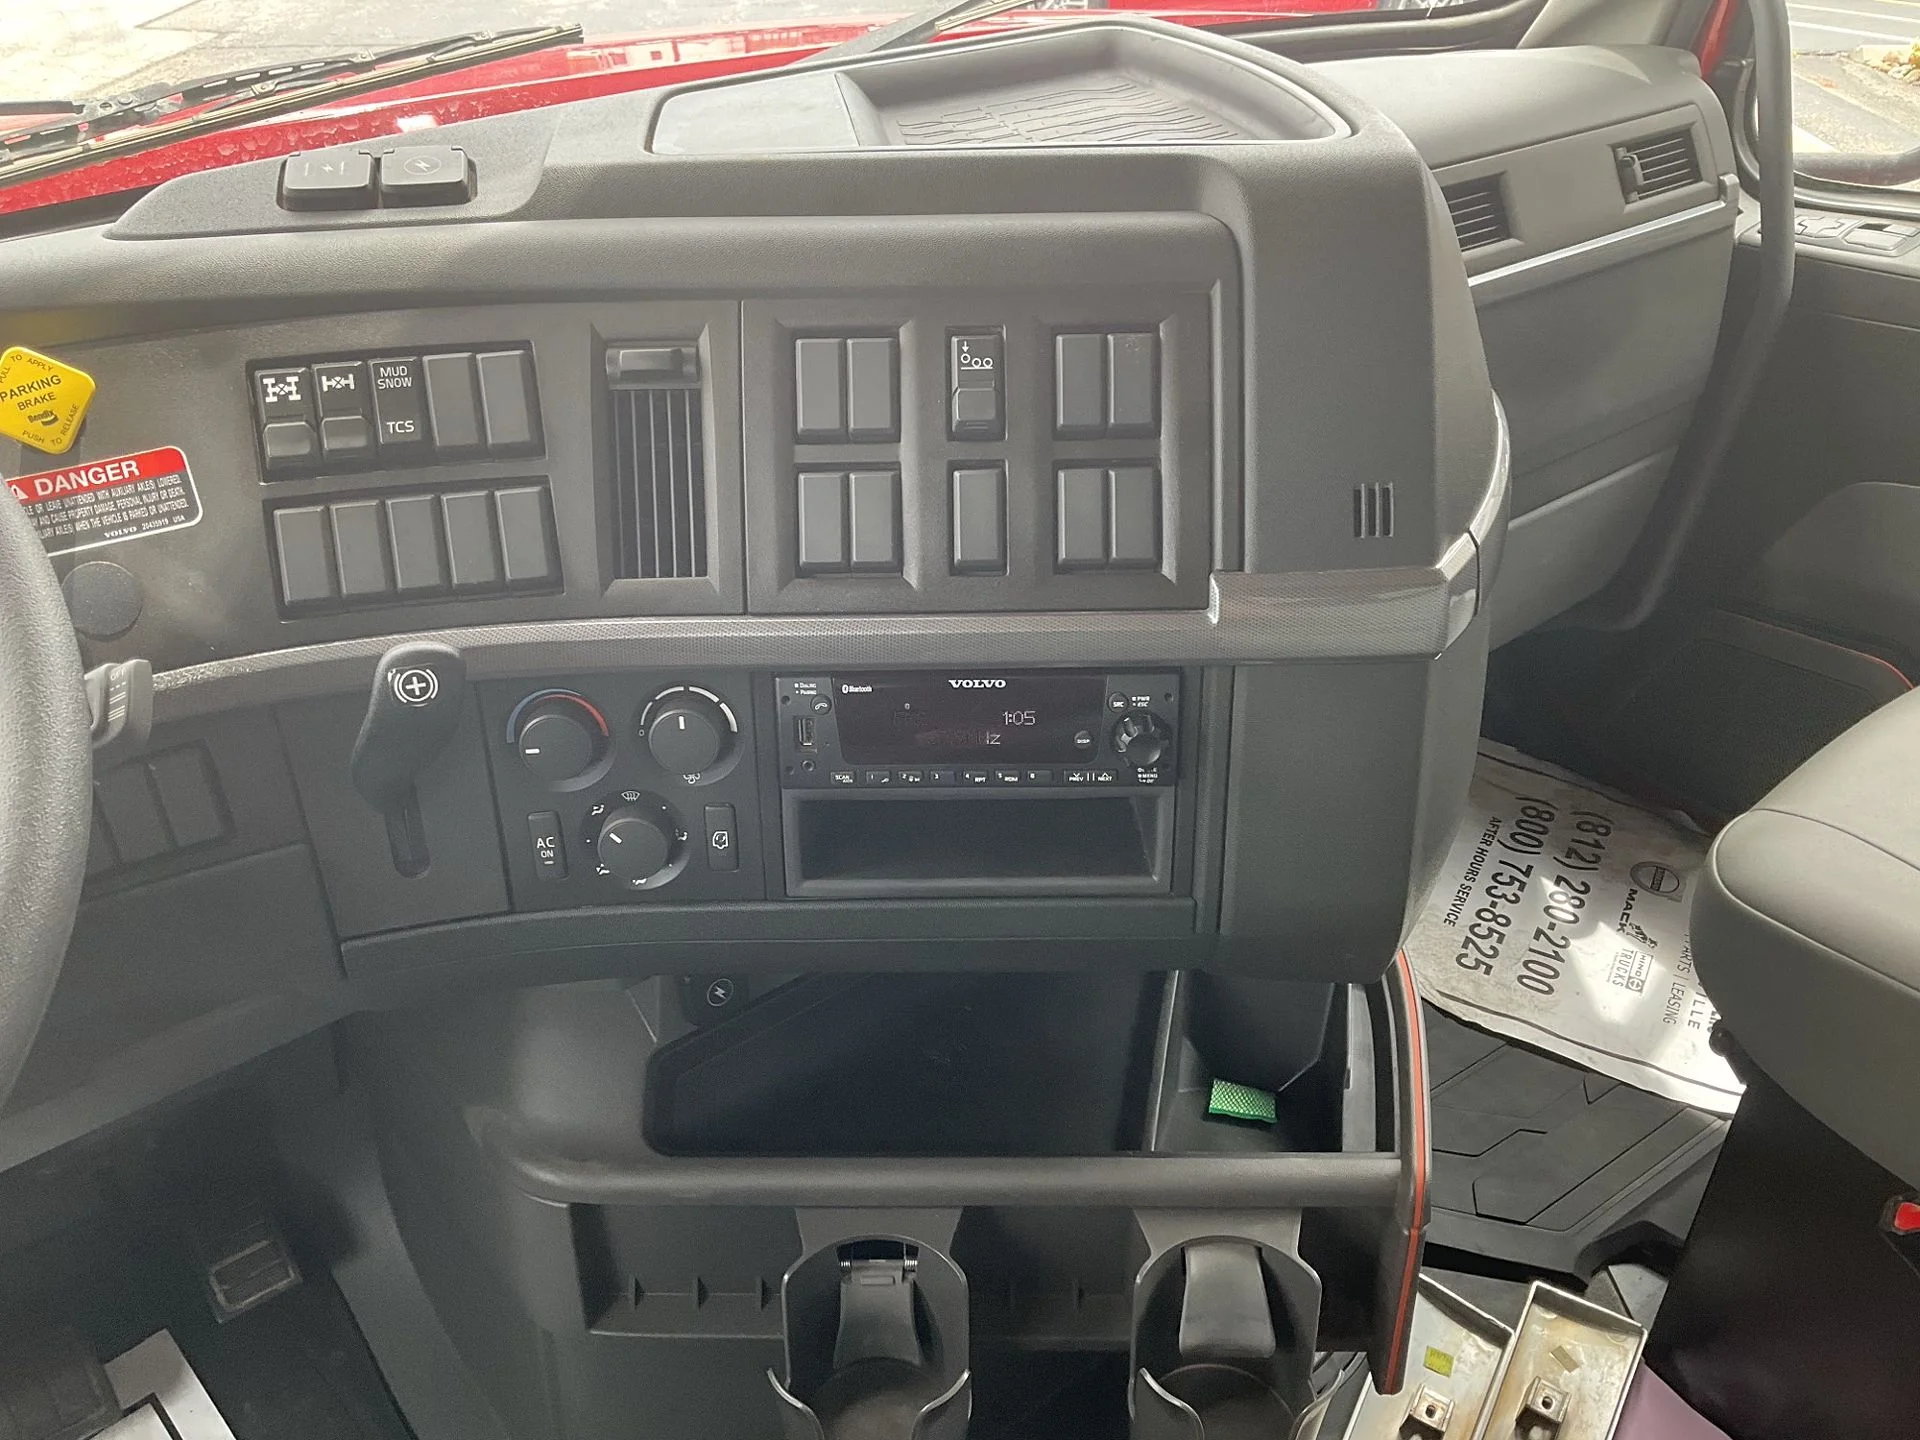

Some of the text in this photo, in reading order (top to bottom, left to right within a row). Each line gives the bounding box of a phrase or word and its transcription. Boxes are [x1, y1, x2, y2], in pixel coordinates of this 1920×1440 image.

[11, 354, 23, 363] TO
[27, 358, 54, 372] APPLY
[380, 365, 408, 378] MUD
[0, 375, 62, 402] PARKING
[378, 376, 413, 389] SNOW
[17, 391, 57, 411] BRAKE
[22, 403, 79, 447] PUSH TO RELEASE
[387, 420, 415, 433] TCS
[33, 460, 140, 496] DANGER
[50, 511, 68, 522] CAUSE
[67, 504, 94, 520] PROPERTY
[116, 495, 142, 510] PERSONAL
[142, 491, 159, 504] INJURY
[63, 492, 95, 508] UNATTENDED
[96, 489, 110, 501] WITH
[110, 483, 135, 498] AUXILIARY
[74, 519, 91, 532] WHEN
[90, 517, 101, 528] THE
[101, 512, 122, 526] VEHICLE
[128, 507, 148, 519] PARKED
[104, 526, 137, 538] VOLVO
[172, 514, 186, 524] USA
[948, 679, 1007, 688] VOLVO
[1002, 710, 1036, 726] 1:05
[536, 836, 555, 849] AC
[540, 850, 554, 858] ON
[1443, 816, 1502, 928] AFTER HOURS SERVICE
[1455, 796, 1559, 976] (800) 753-8525
[1516, 810, 1614, 996] (812) 280-2100
[1616, 888, 1638, 934] MACK
[1612, 947, 1634, 988] TRUCKS
[1635, 953, 1648, 977] HINO
[1662, 981, 1686, 1025] LEASING
